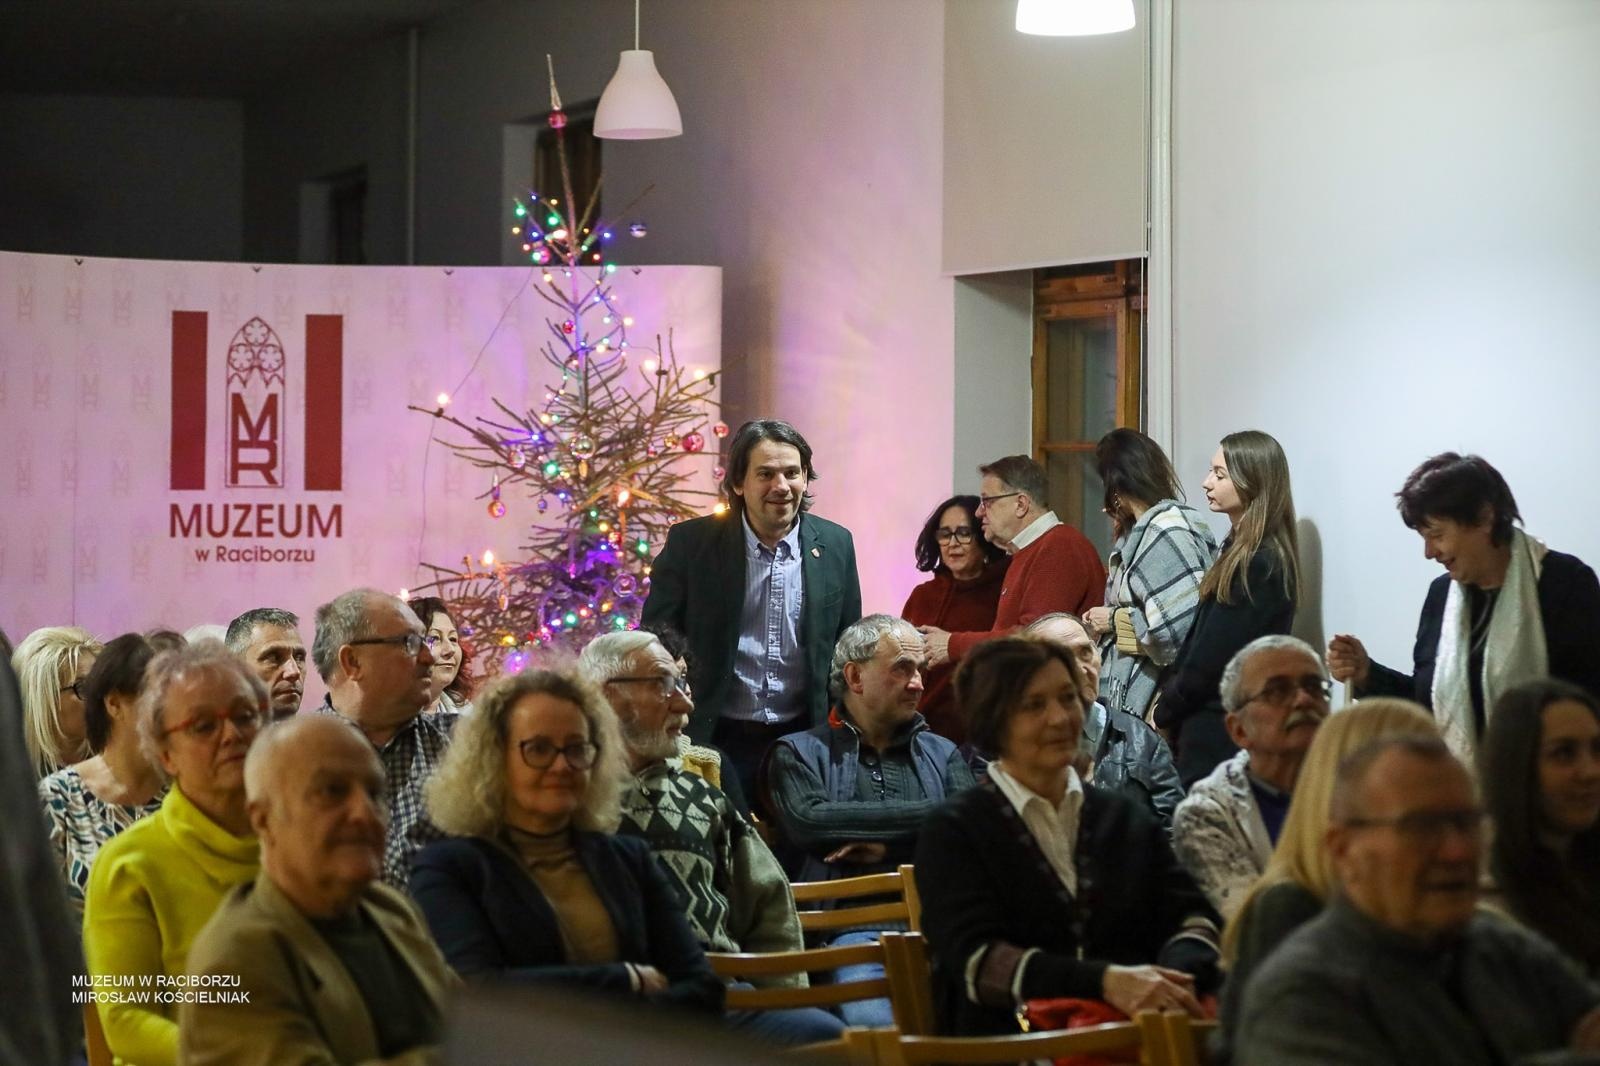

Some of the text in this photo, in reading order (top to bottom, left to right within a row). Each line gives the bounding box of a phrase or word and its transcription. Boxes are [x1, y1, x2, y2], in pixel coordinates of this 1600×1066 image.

[169, 502, 343, 538] MUZEUM
[195, 545, 315, 563] w Raciborzu
